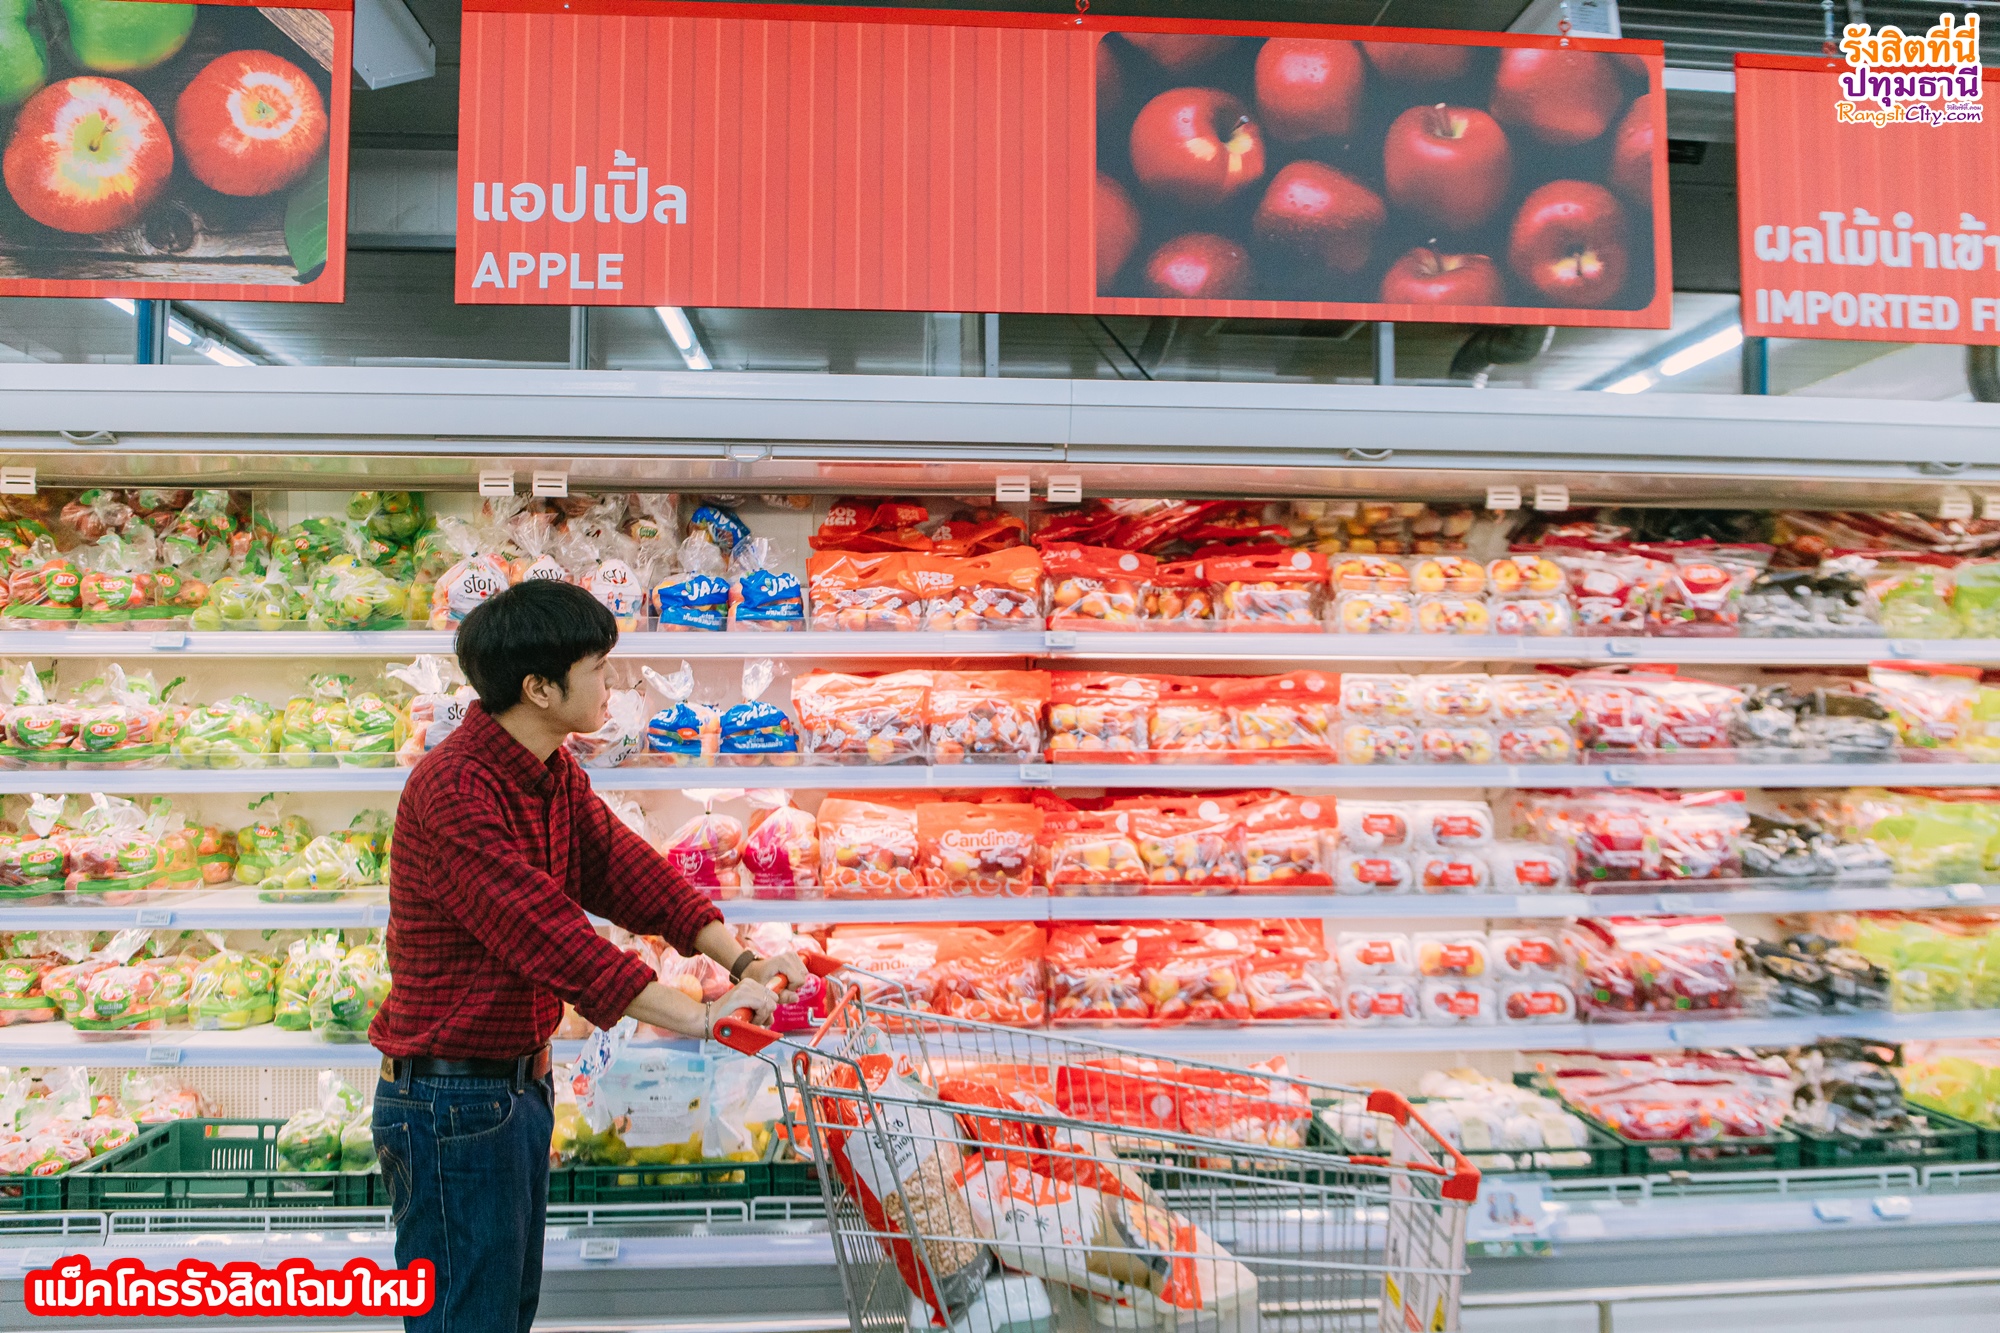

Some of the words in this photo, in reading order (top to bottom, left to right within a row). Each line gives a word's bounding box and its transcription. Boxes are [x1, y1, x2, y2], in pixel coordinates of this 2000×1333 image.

[472, 149, 688, 225] แอปเปิ้ล
[471, 251, 625, 290] APPLE
[1755, 288, 1960, 331] IMPORTED
[54, 572, 76, 585] aro
[447, 701, 467, 720] sto
[93, 724, 116, 734] aro
[944, 830, 1017, 848] Candine
[855, 952, 930, 973] Candin
